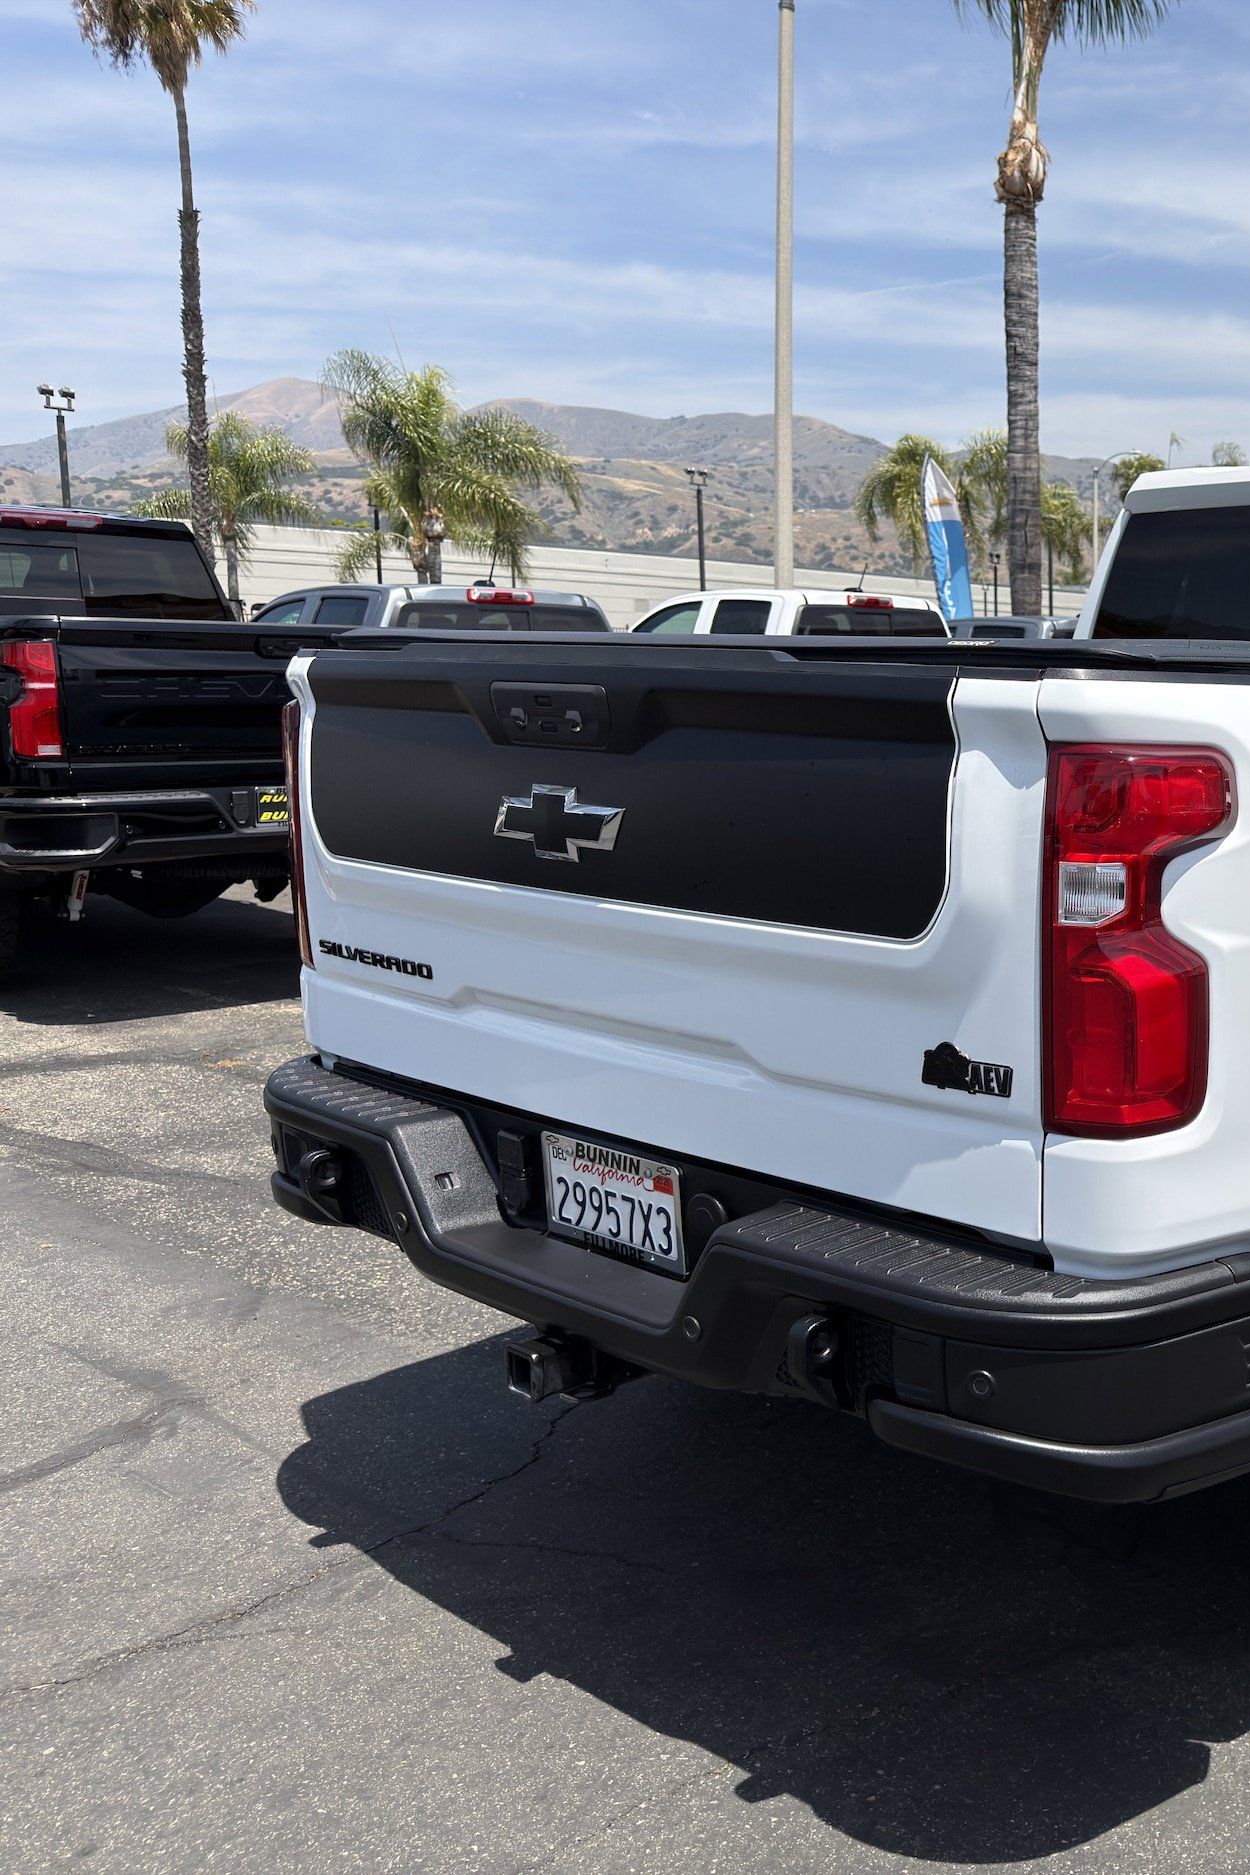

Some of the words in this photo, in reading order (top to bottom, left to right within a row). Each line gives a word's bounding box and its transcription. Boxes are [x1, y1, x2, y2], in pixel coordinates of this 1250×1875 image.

[319, 939, 433, 980] SILVERADO
[969, 1062, 1010, 1094] AEV
[573, 1157, 654, 1192] California
[575, 1141, 641, 1176] BUNNIN
[556, 1176, 673, 1256] 29957X3
[583, 1231, 645, 1263] FILLMORE
